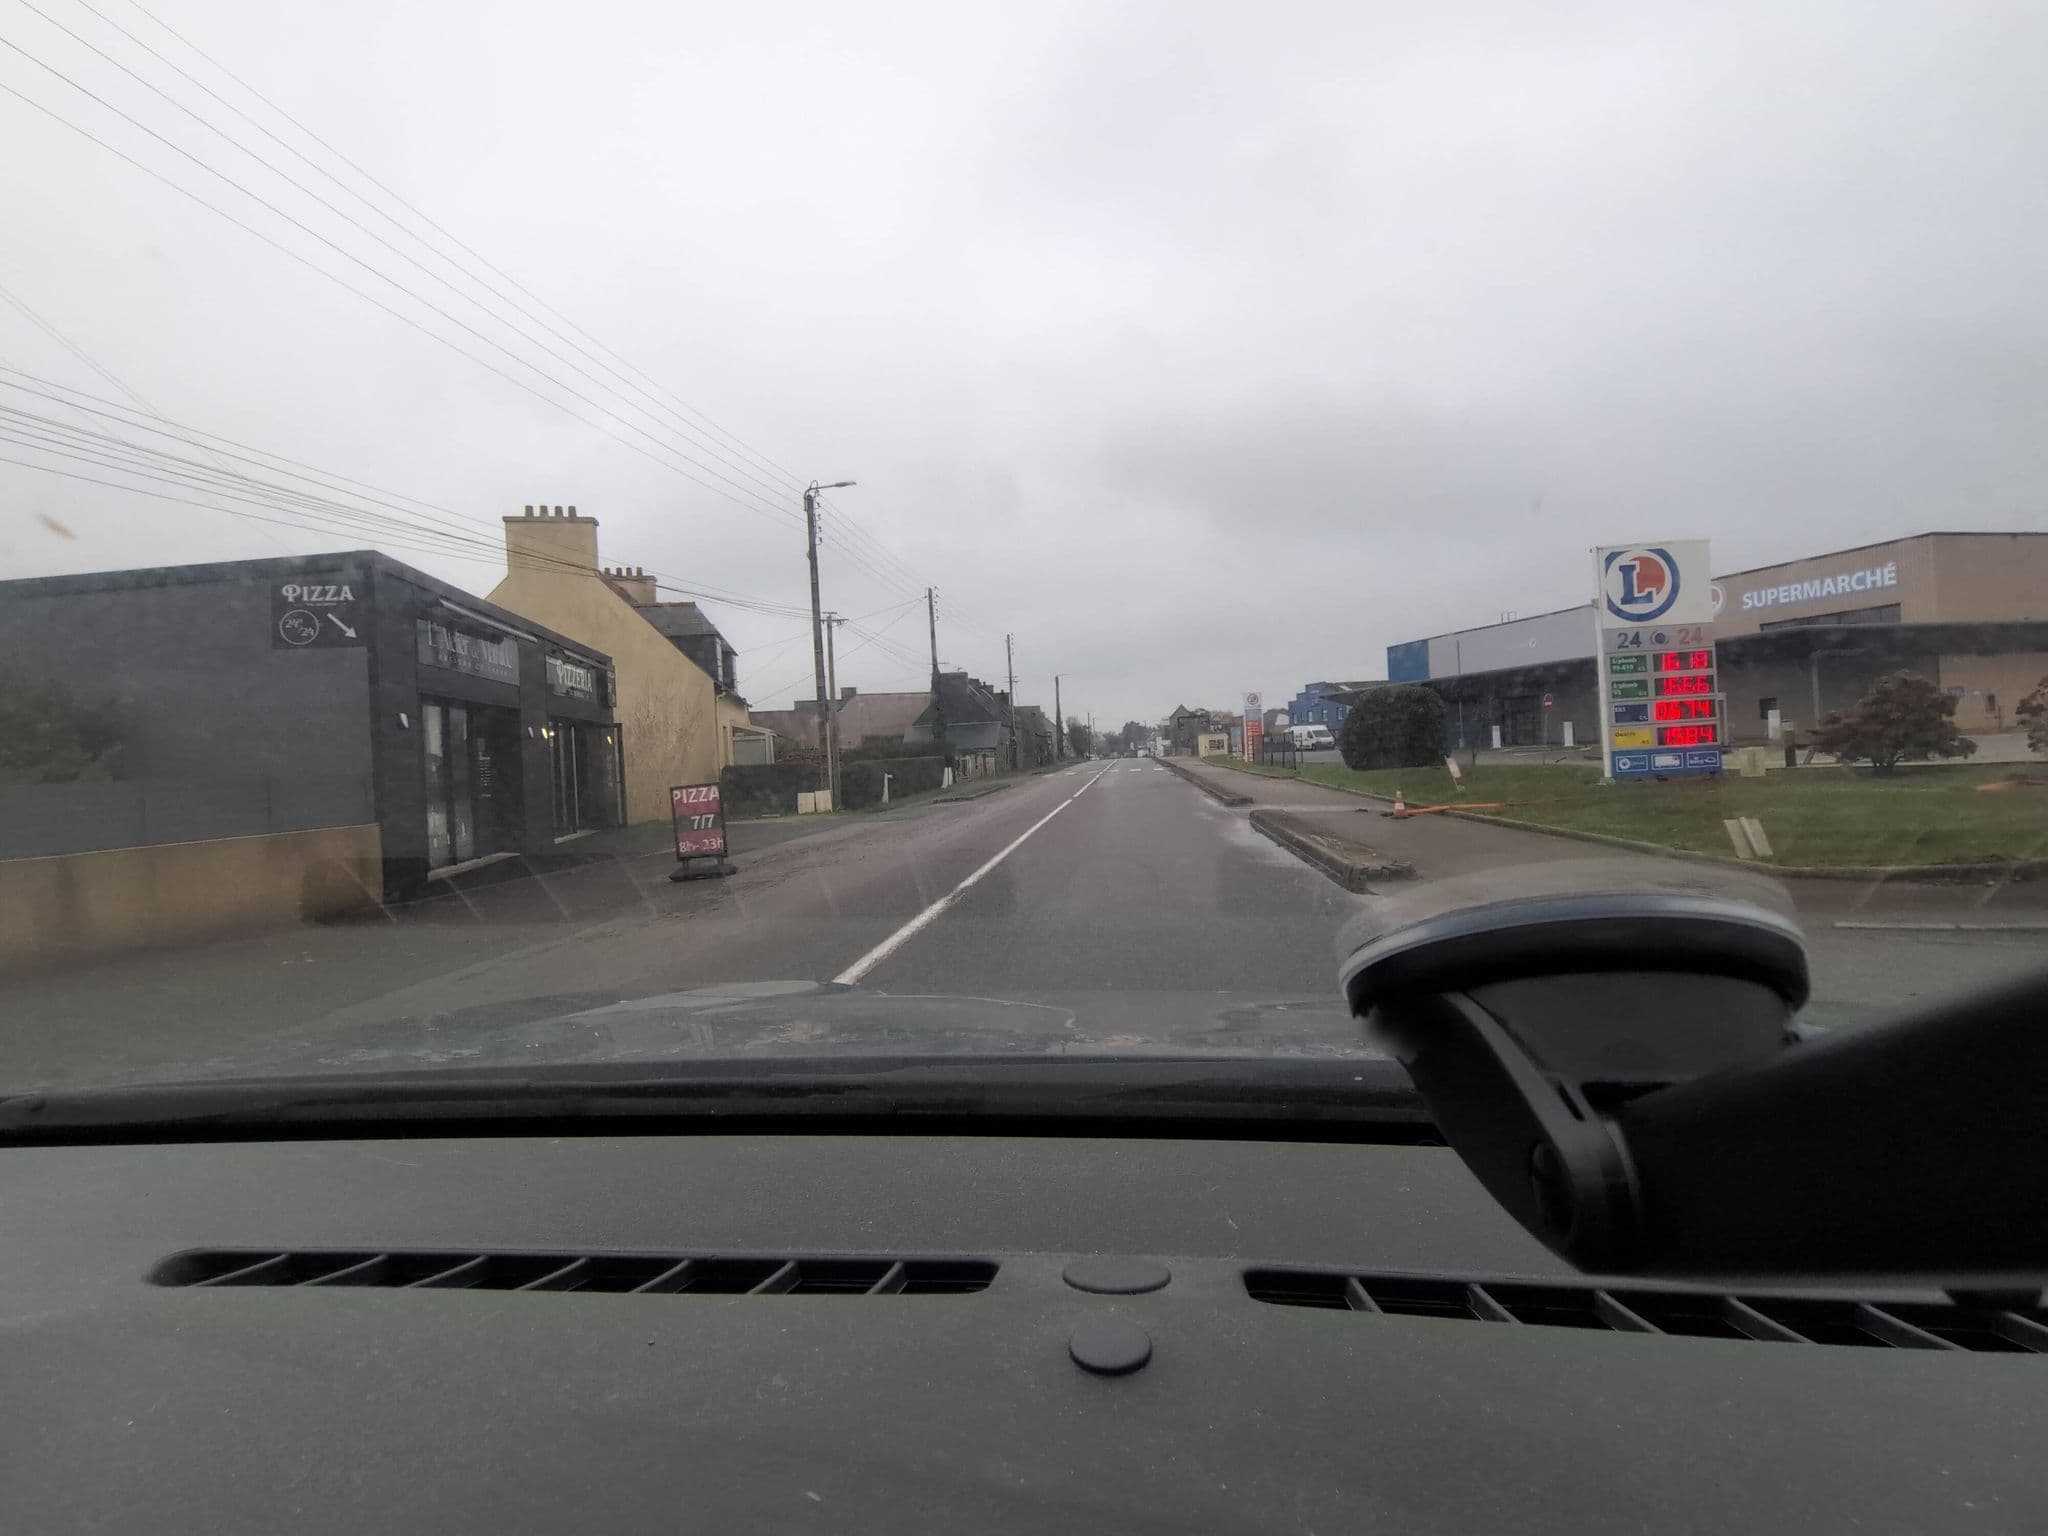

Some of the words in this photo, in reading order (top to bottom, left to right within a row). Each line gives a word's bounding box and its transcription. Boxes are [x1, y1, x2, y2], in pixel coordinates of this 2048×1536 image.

[282, 584, 356, 602] PIZZA
[1619, 564, 1654, 605] L
[1742, 562, 1897, 610] SUPERMARCHÉ
[1617, 631, 1642, 649] 24
[557, 660, 593, 693] PIZZERIA
[673, 785, 719, 803] PIZZA
